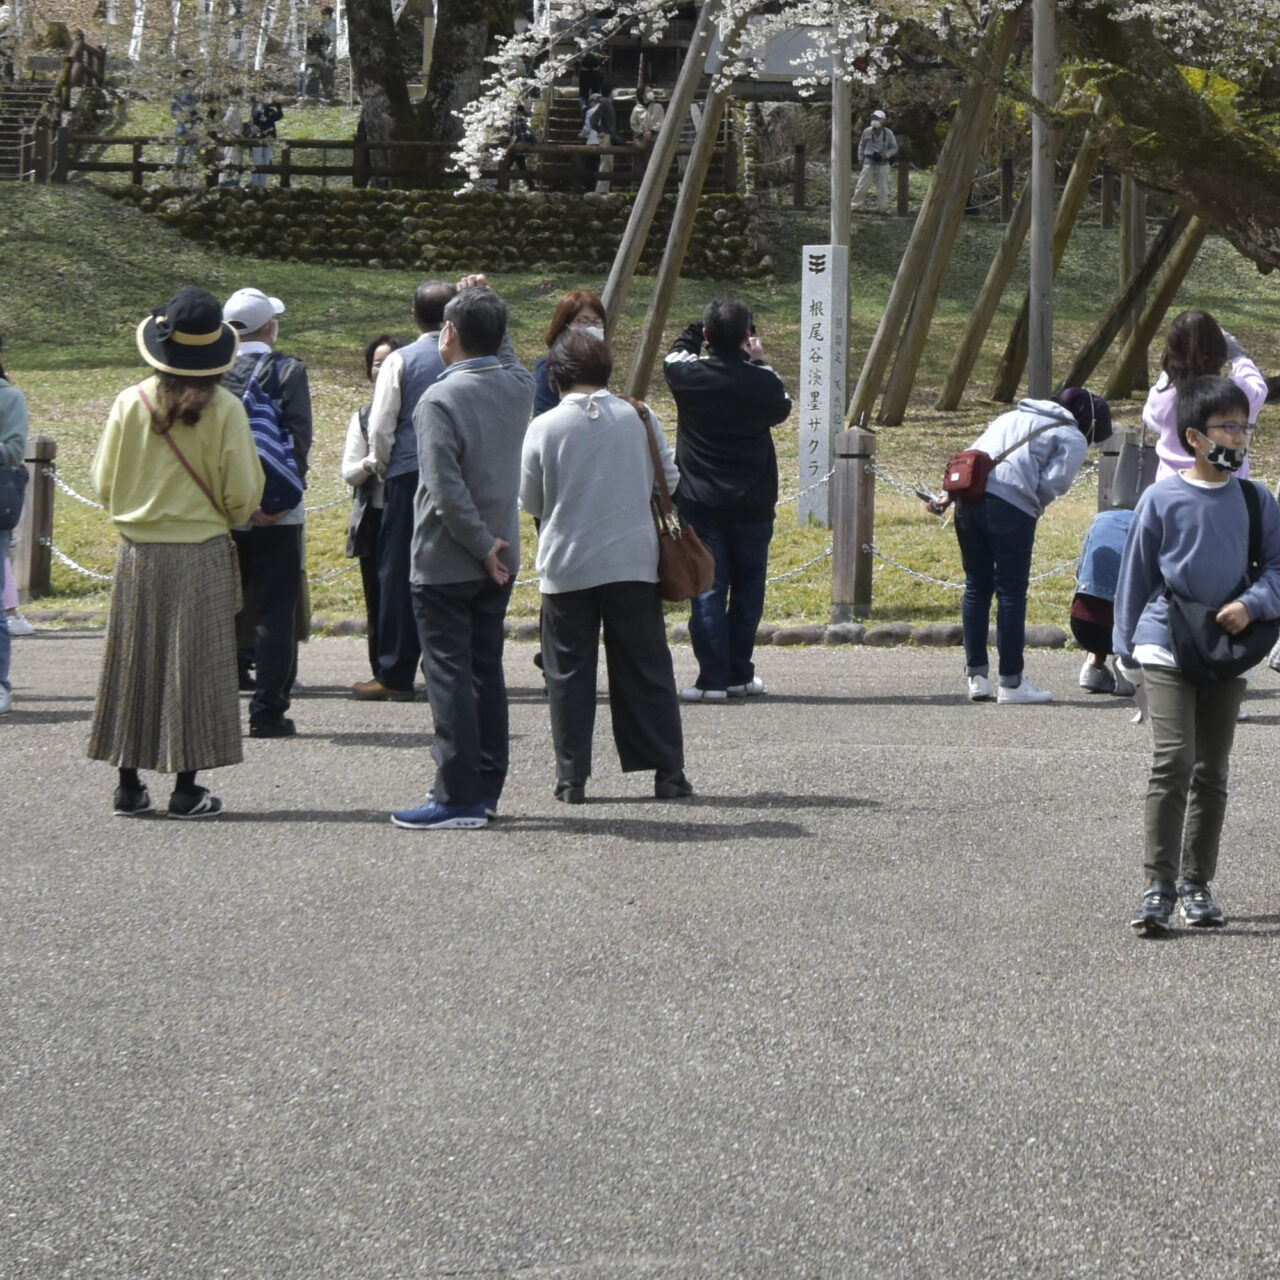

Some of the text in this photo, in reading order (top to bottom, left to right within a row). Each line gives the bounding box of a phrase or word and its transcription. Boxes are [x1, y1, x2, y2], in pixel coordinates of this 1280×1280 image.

[808, 299, 824, 476] 根尾谷淡墨ザクラ
